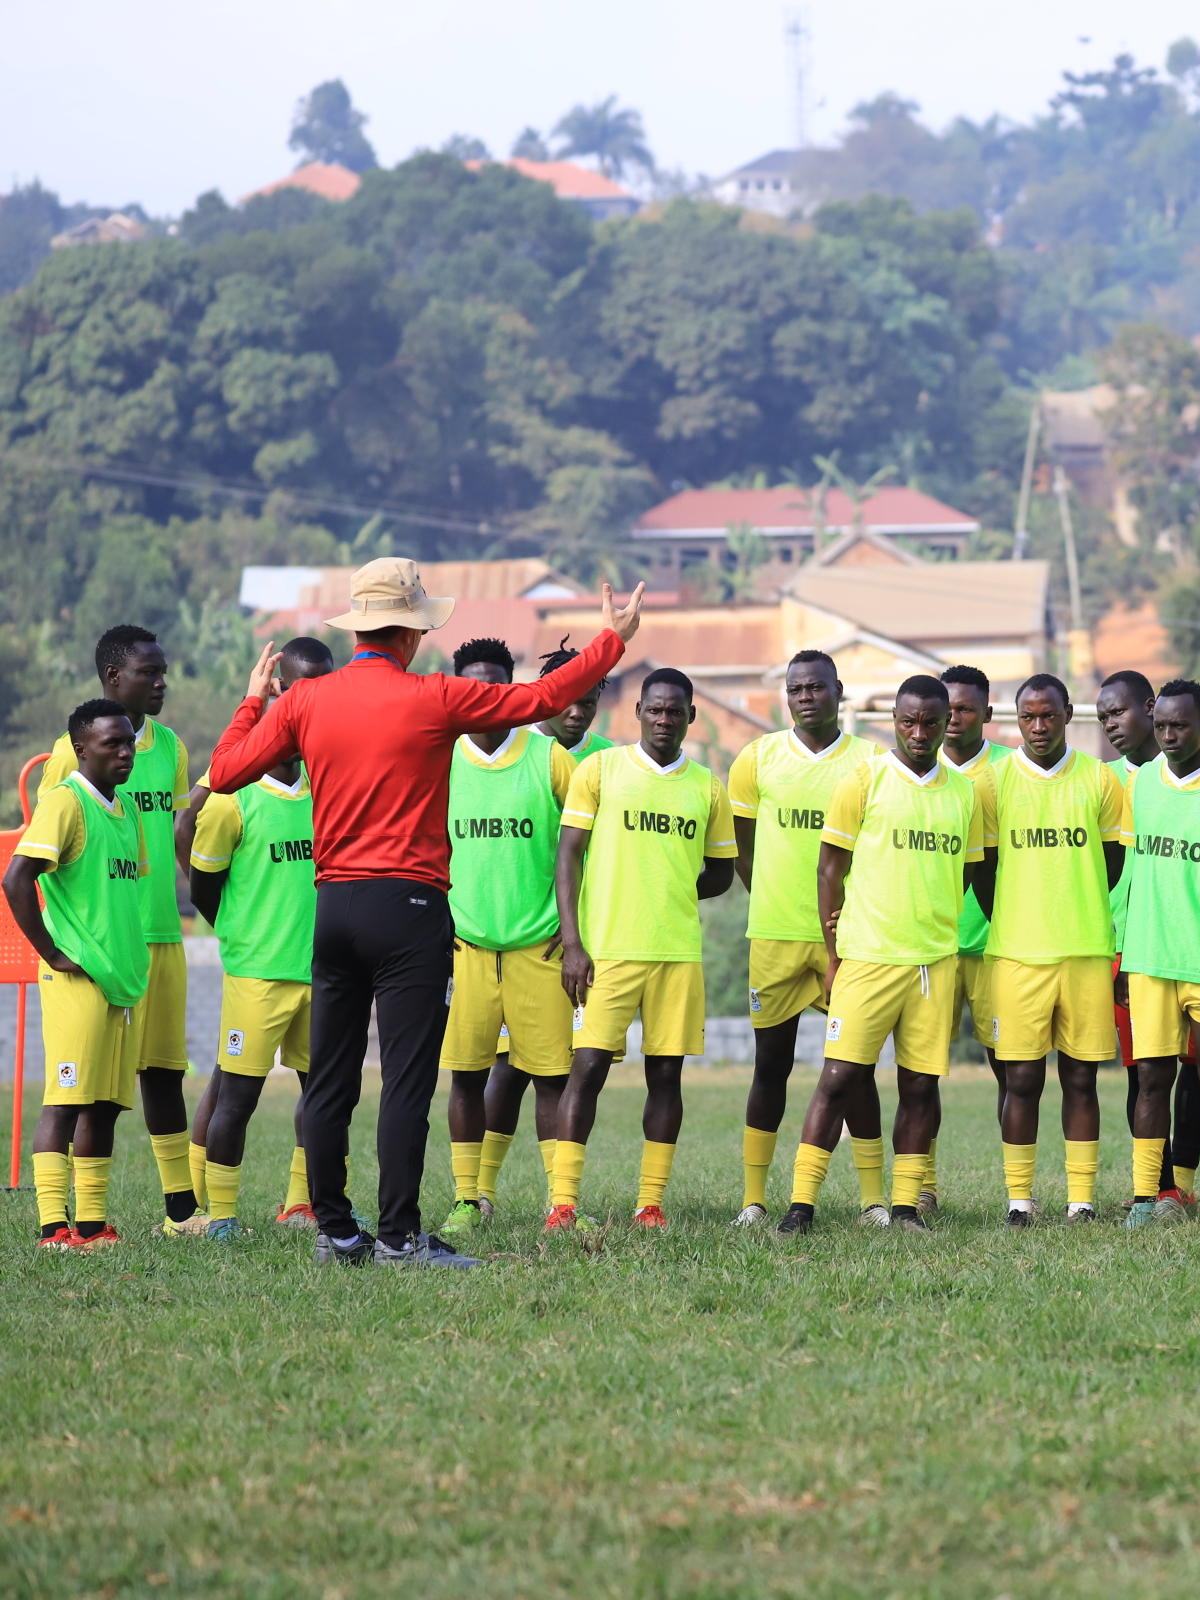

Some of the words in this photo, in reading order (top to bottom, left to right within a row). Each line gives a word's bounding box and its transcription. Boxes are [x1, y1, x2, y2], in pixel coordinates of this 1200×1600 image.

[454, 817, 534, 840] UMBRO
[623, 809, 697, 841] UMBRO
[778, 808, 826, 830] UMB
[892, 828, 963, 856] UMBRO
[1010, 827, 1088, 850] UMBRO
[269, 839, 314, 863] UMB
